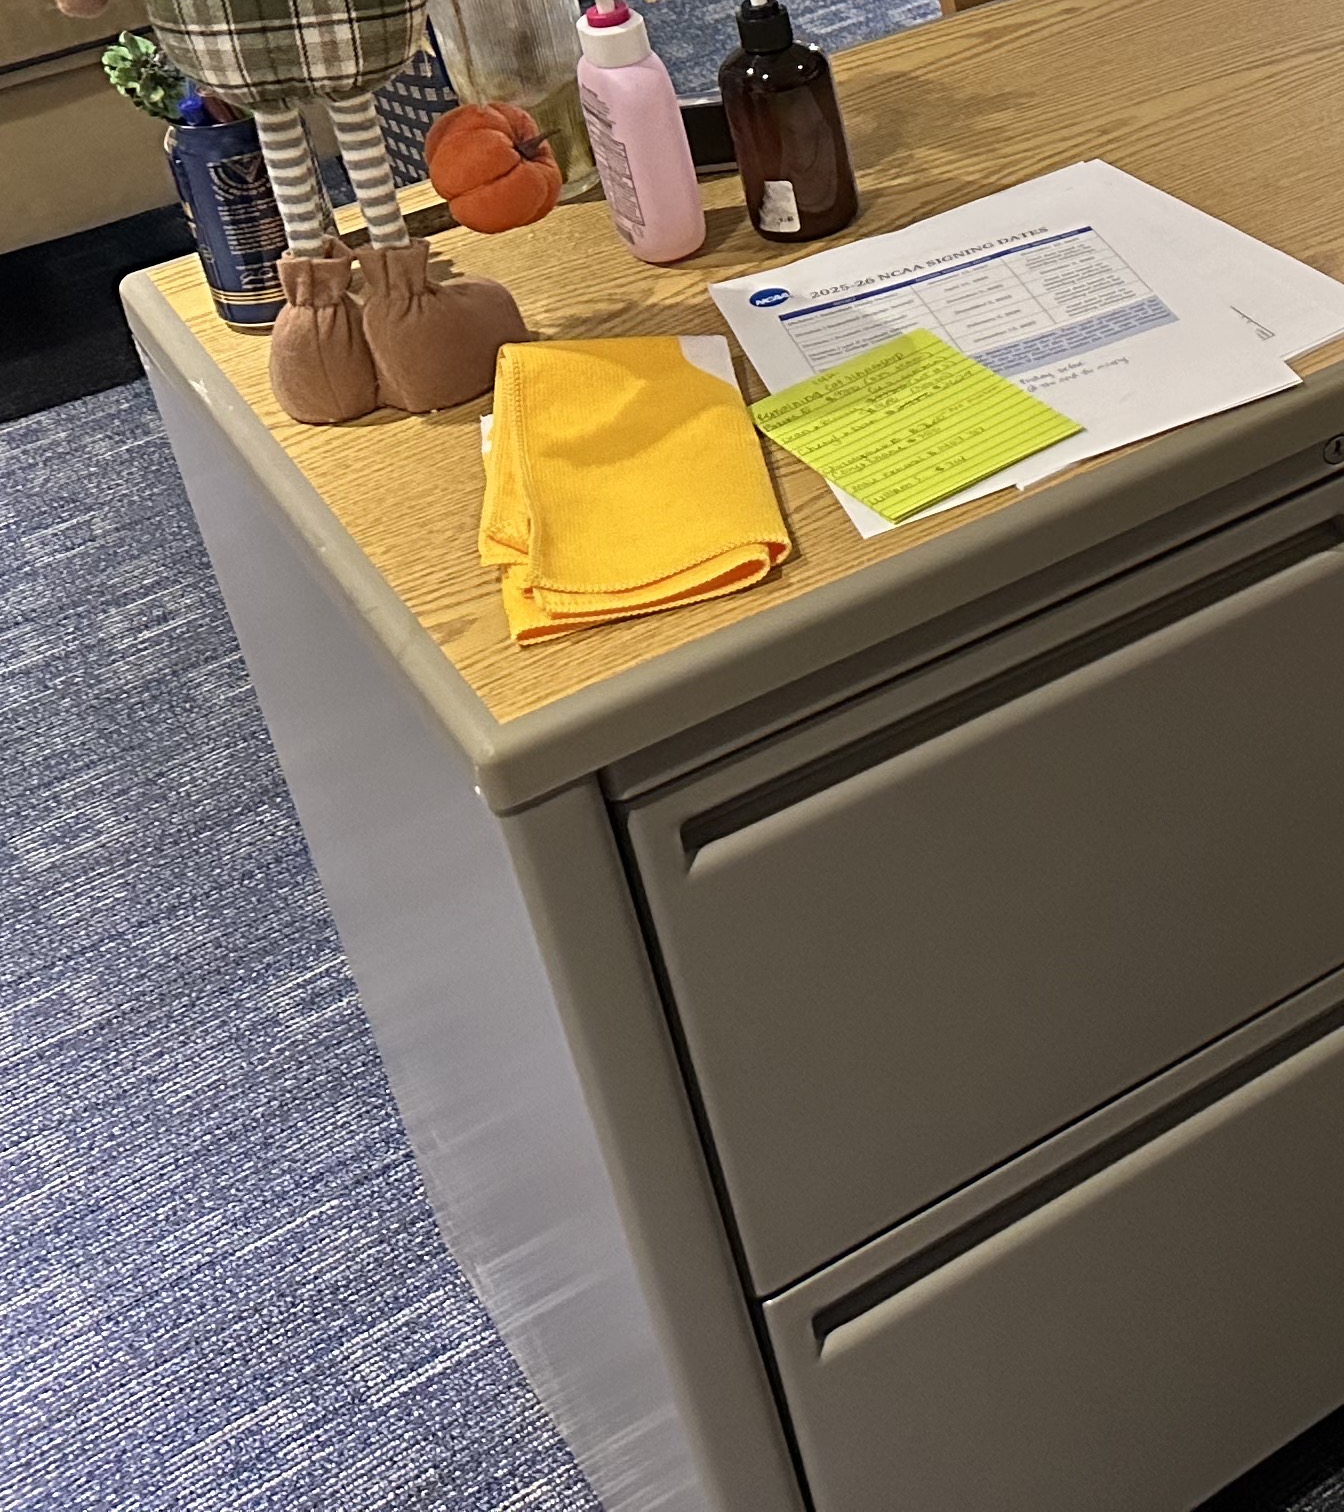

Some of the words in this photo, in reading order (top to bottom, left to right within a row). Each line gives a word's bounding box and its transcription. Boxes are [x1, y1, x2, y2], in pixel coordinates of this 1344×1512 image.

[810, 277, 876, 299] 2025-26
[878, 264, 925, 281] NCAA
[926, 242, 994, 267] SIGNING
[998, 227, 1049, 245] DATES
[755, 291, 791, 307] NCAA
